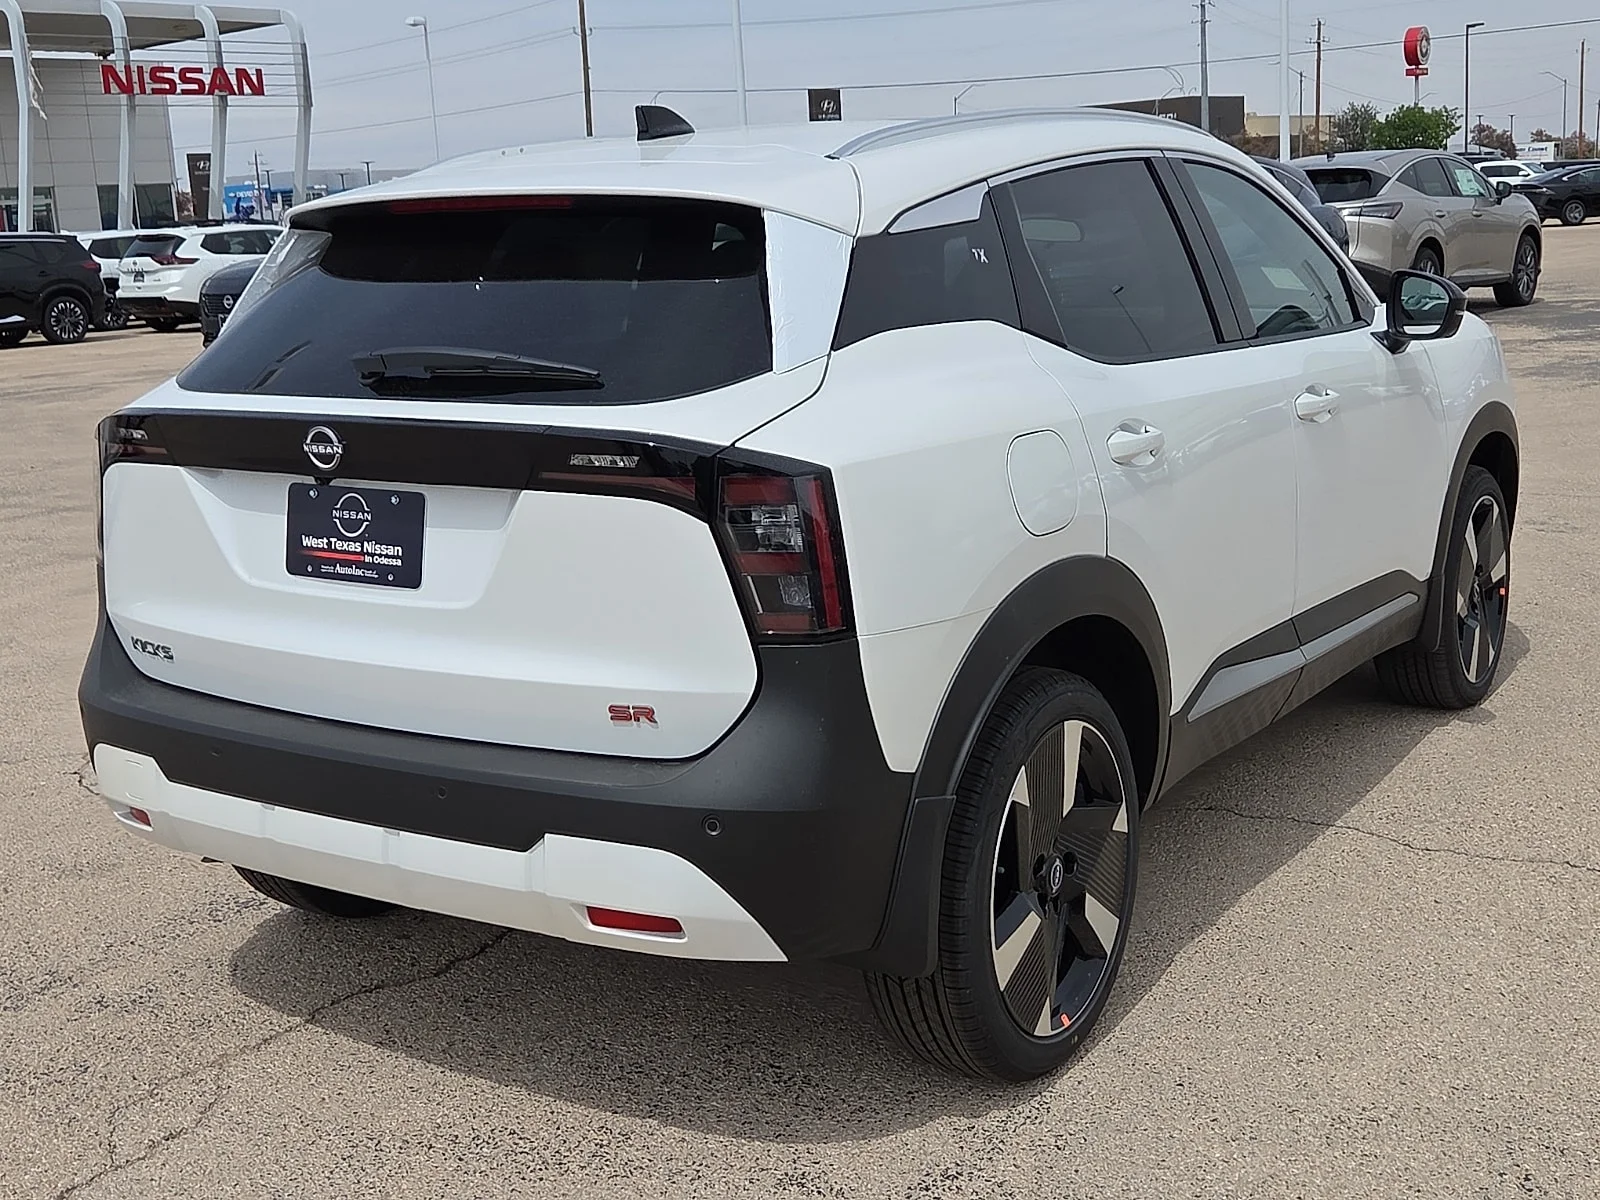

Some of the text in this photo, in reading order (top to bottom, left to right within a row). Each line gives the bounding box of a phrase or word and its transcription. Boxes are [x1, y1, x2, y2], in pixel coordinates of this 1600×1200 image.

[101, 64, 265, 96] NISSAN
[303, 443, 343, 454] NISSAN
[332, 509, 372, 521] NISSAN
[301, 535, 402, 556] West Texas Nissan
[373, 556, 402, 567] Odessa
[334, 563, 365, 577] AutoInc
[131, 636, 174, 660] KICKS
[608, 705, 658, 724] SR
